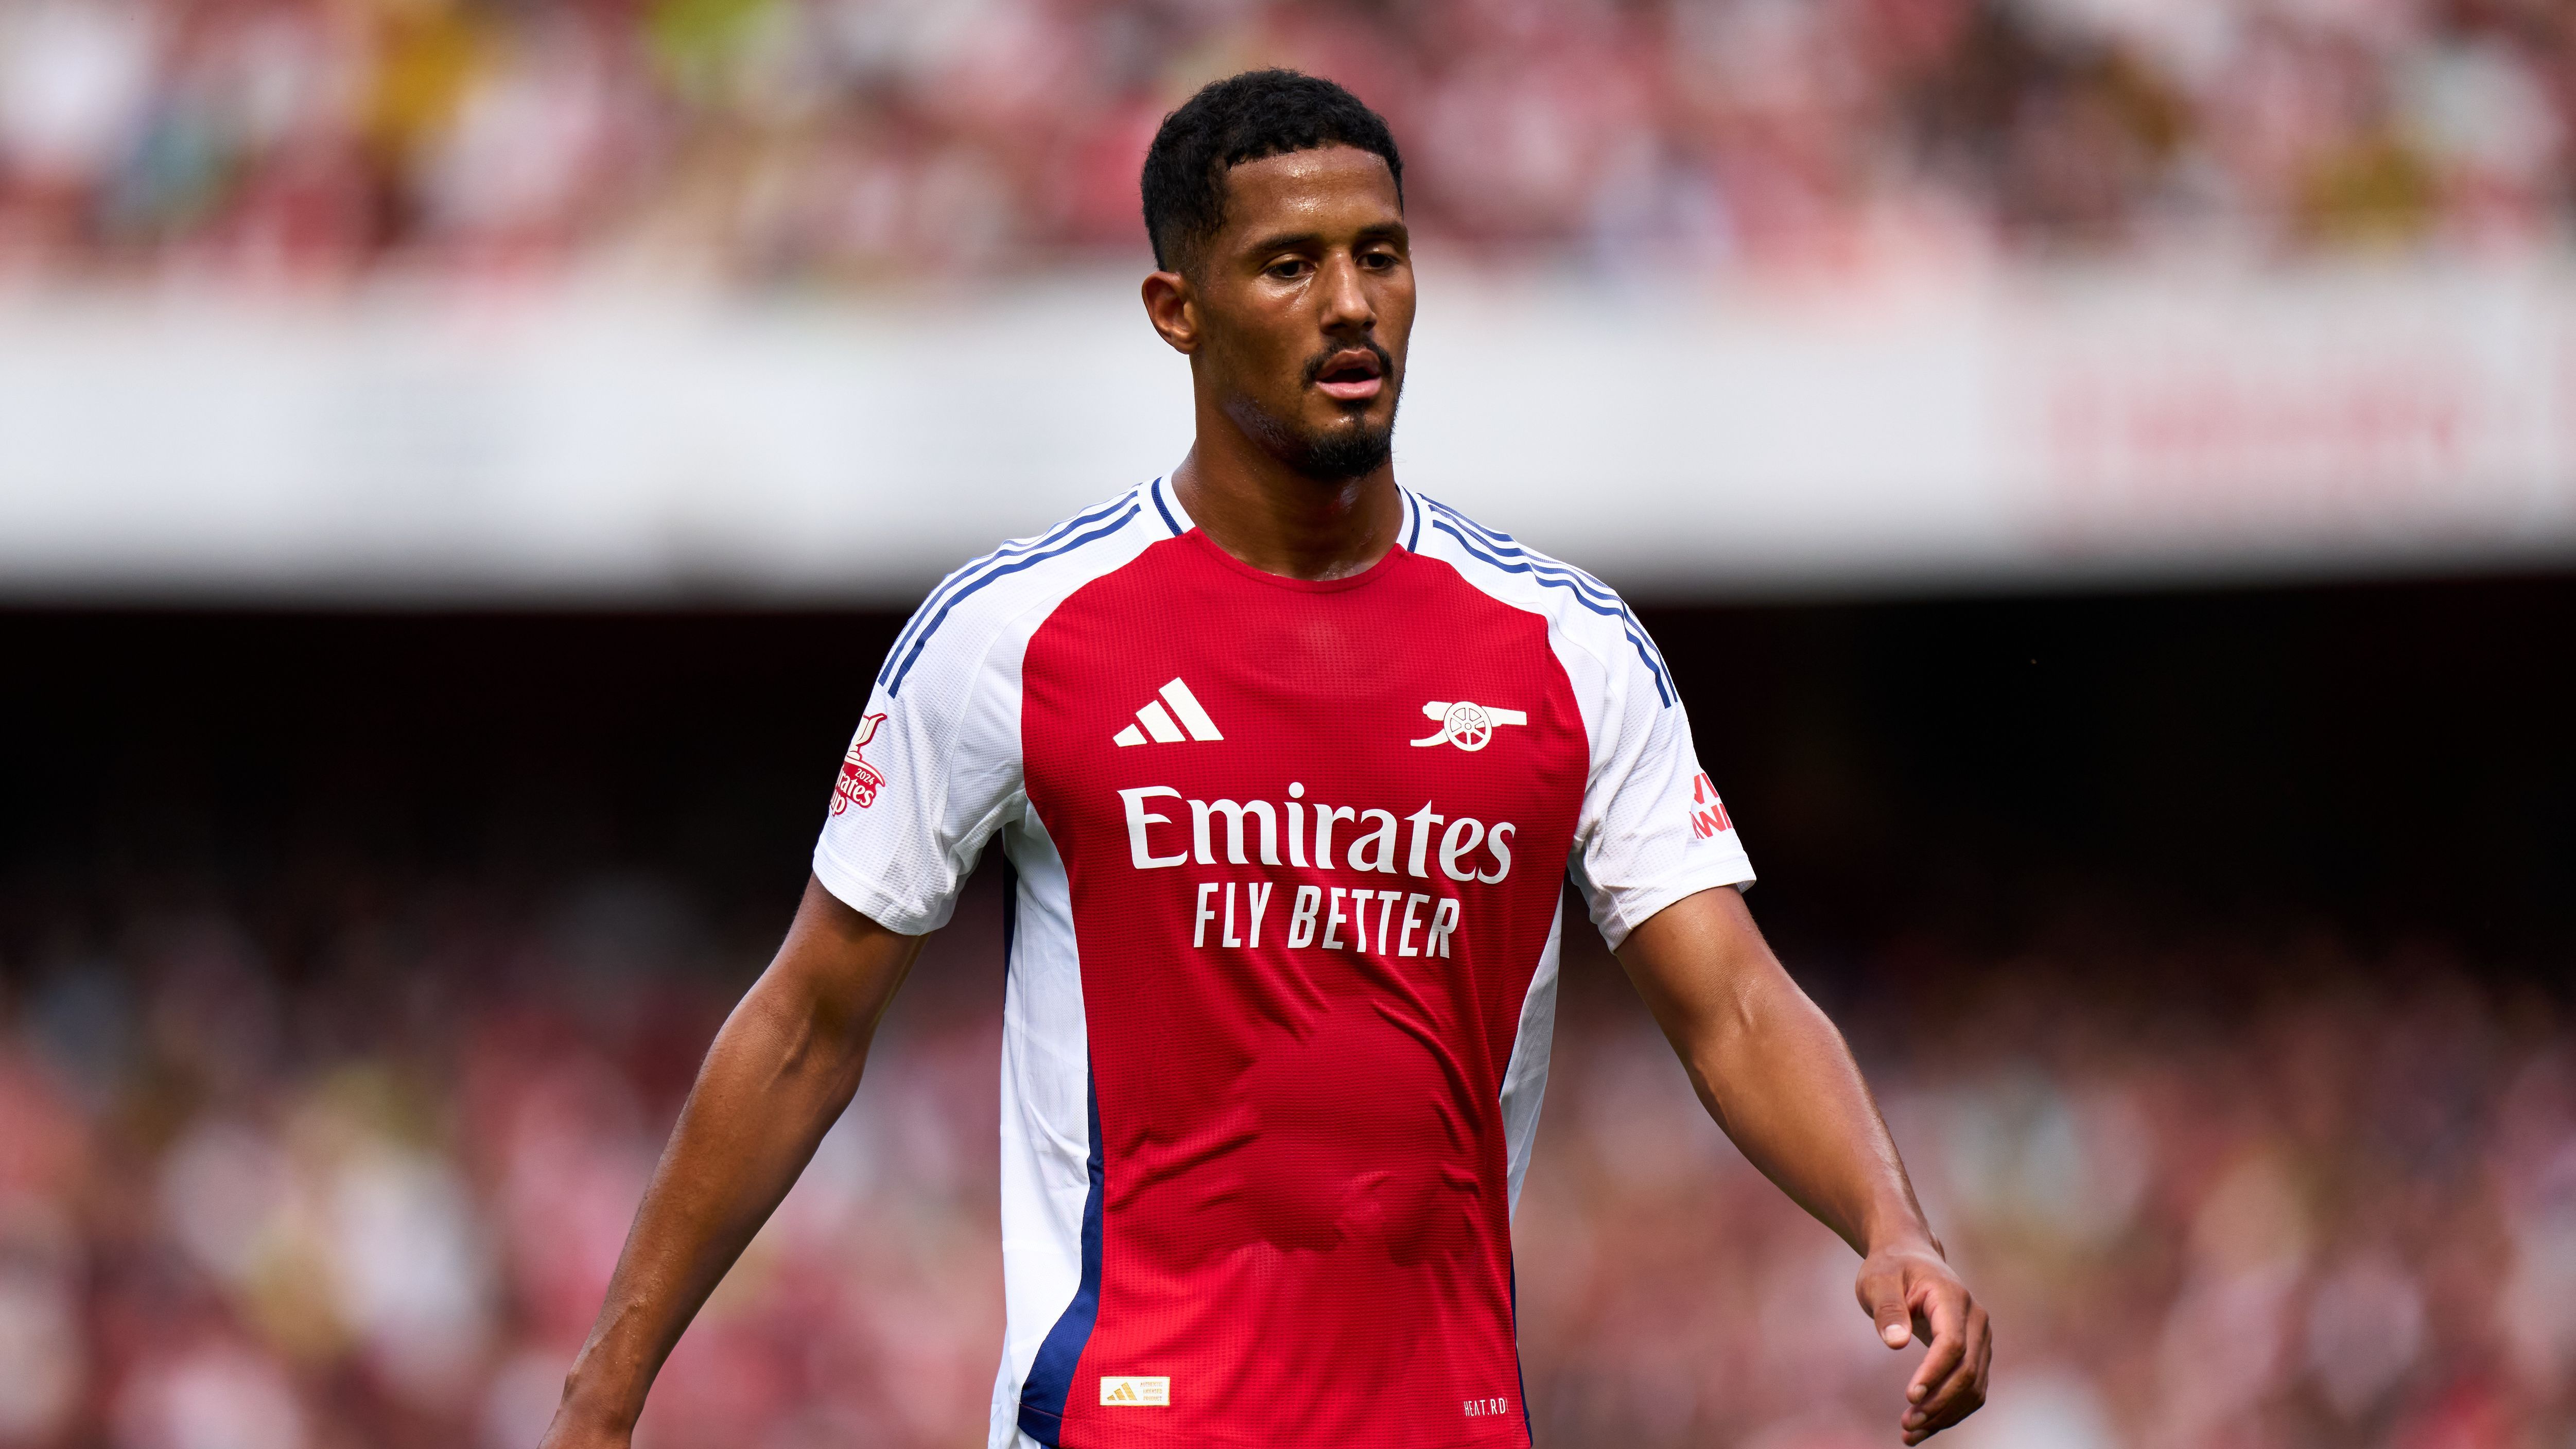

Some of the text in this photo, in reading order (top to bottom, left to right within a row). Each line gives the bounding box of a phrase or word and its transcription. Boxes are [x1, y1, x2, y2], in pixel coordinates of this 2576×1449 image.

[855, 768, 875, 785] 2024
[830, 789, 846, 815] up
[1116, 781, 1517, 885] Emirates
[1193, 881, 1460, 959] FLY BETTER
[1464, 1398, 1509, 1417] HEAT.RD
